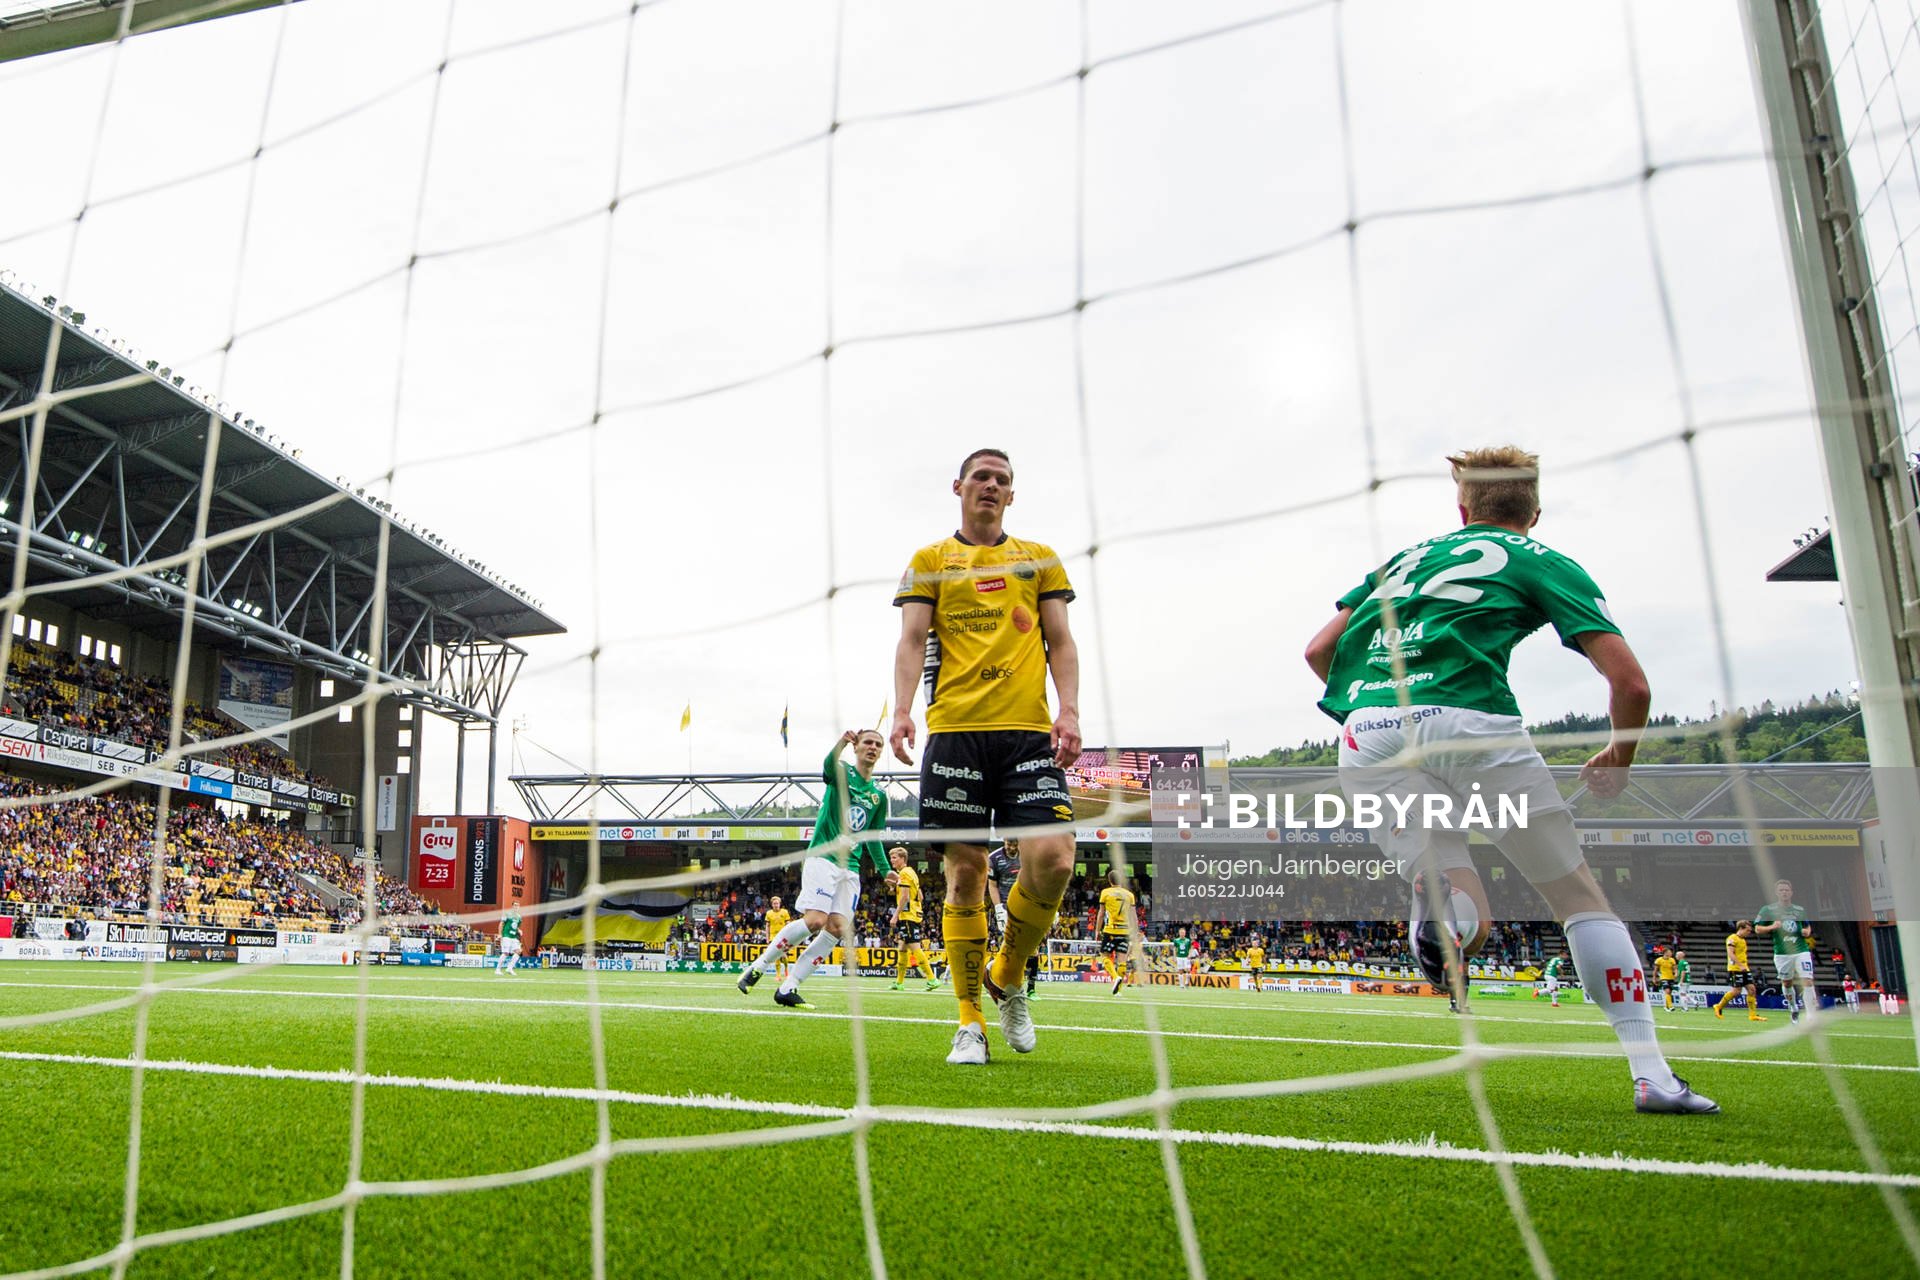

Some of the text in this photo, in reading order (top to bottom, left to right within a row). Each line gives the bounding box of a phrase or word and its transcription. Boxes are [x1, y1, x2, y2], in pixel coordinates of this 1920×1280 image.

[946, 608, 1004, 621] Swedbank
[949, 621, 997, 635] Sjuhärad
[981, 665, 1012, 681] ellos
[1355, 706, 1442, 734] Riksbyggen
[97, 760, 115, 771] SEB
[1157, 762, 1165, 773] 2
[1182, 761, 1190, 773] 0
[1156, 779, 1193, 790] 64:42
[635, 829, 656, 839] net
[711, 830, 724, 838] put
[1193, 829, 1231, 839] Swedbank
[1286, 828, 1319, 843] ellos
[1329, 828, 1364, 843] ellos
[1633, 832, 1650, 844] put
[1662, 829, 1693, 844] net
[1716, 829, 1747, 844] net
[423, 833, 454, 849] City
[425, 868, 449, 879] 7-23
[171, 928, 226, 943] Mediacad
[598, 960, 623, 970] TIPS
